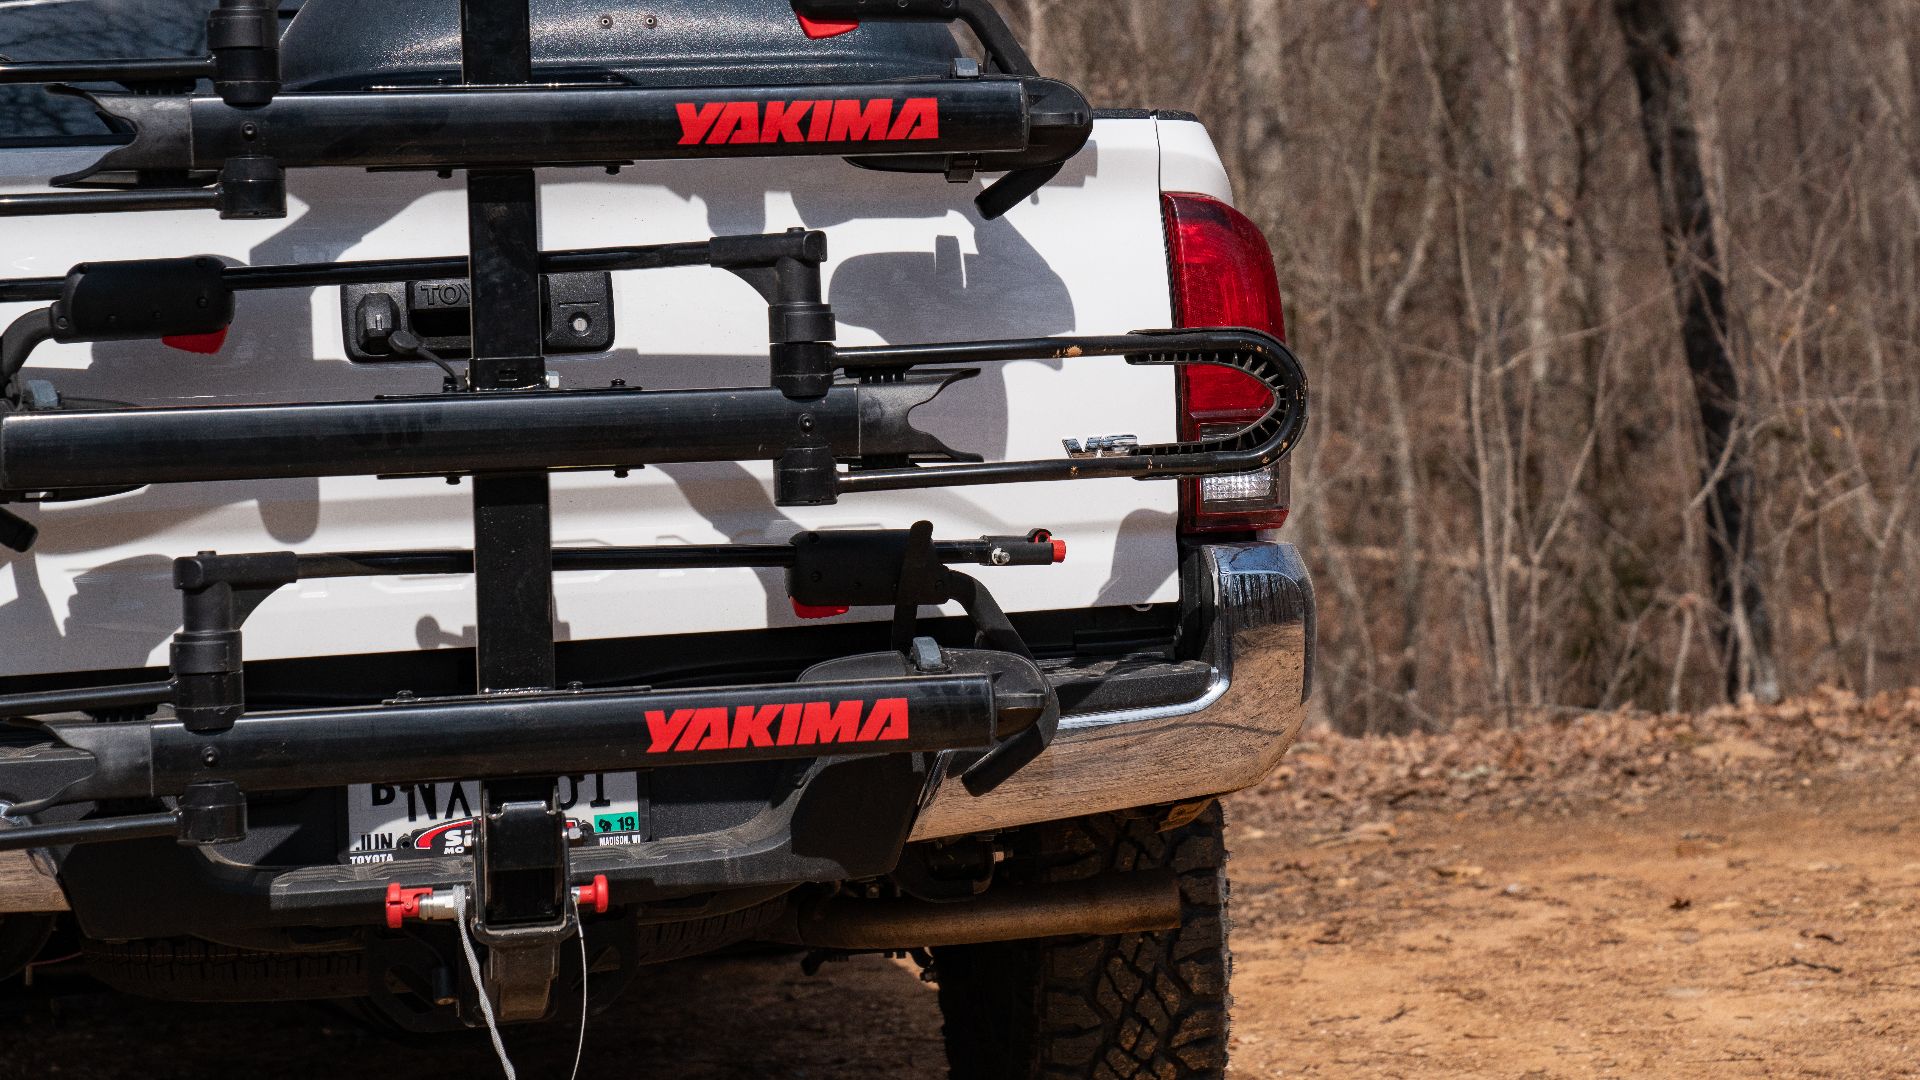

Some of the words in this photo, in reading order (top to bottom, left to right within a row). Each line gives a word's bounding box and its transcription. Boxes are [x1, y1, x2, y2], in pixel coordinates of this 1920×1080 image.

[676, 98, 938, 144] YAKIMA
[645, 698, 908, 752] YAKIMA
[617, 815, 635, 831] 19
[349, 853, 394, 865] TOYOTA
